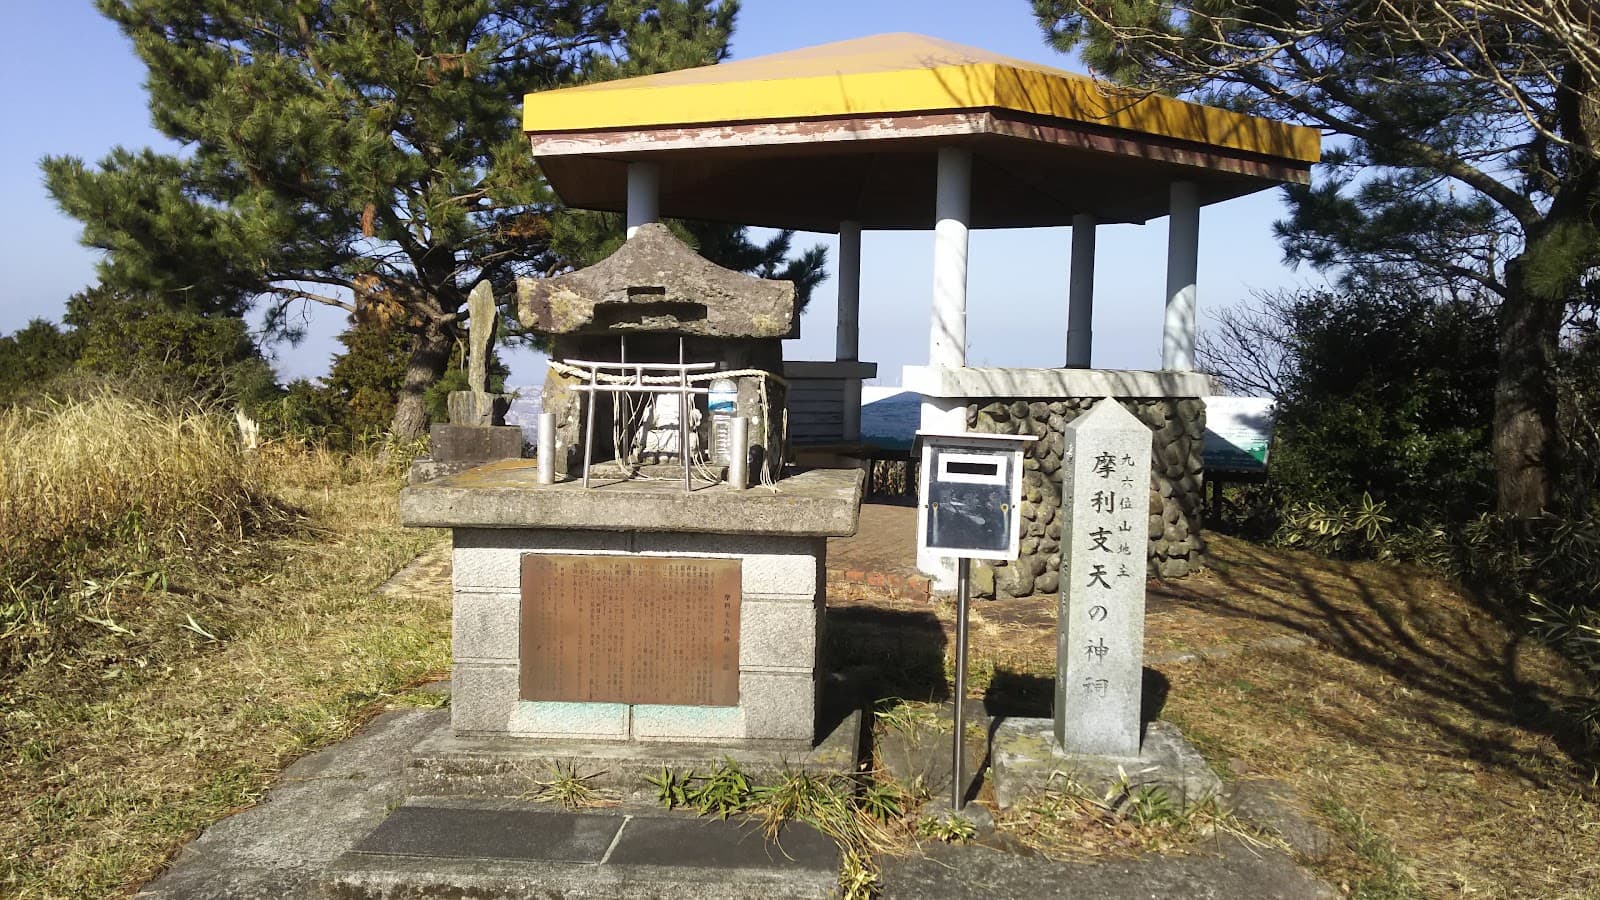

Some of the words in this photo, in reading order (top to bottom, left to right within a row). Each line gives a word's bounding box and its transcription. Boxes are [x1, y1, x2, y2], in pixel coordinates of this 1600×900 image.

[1082, 451, 1117, 698] 摩利支天の神祠
[1117, 453, 1135, 577] 九六位山地主
